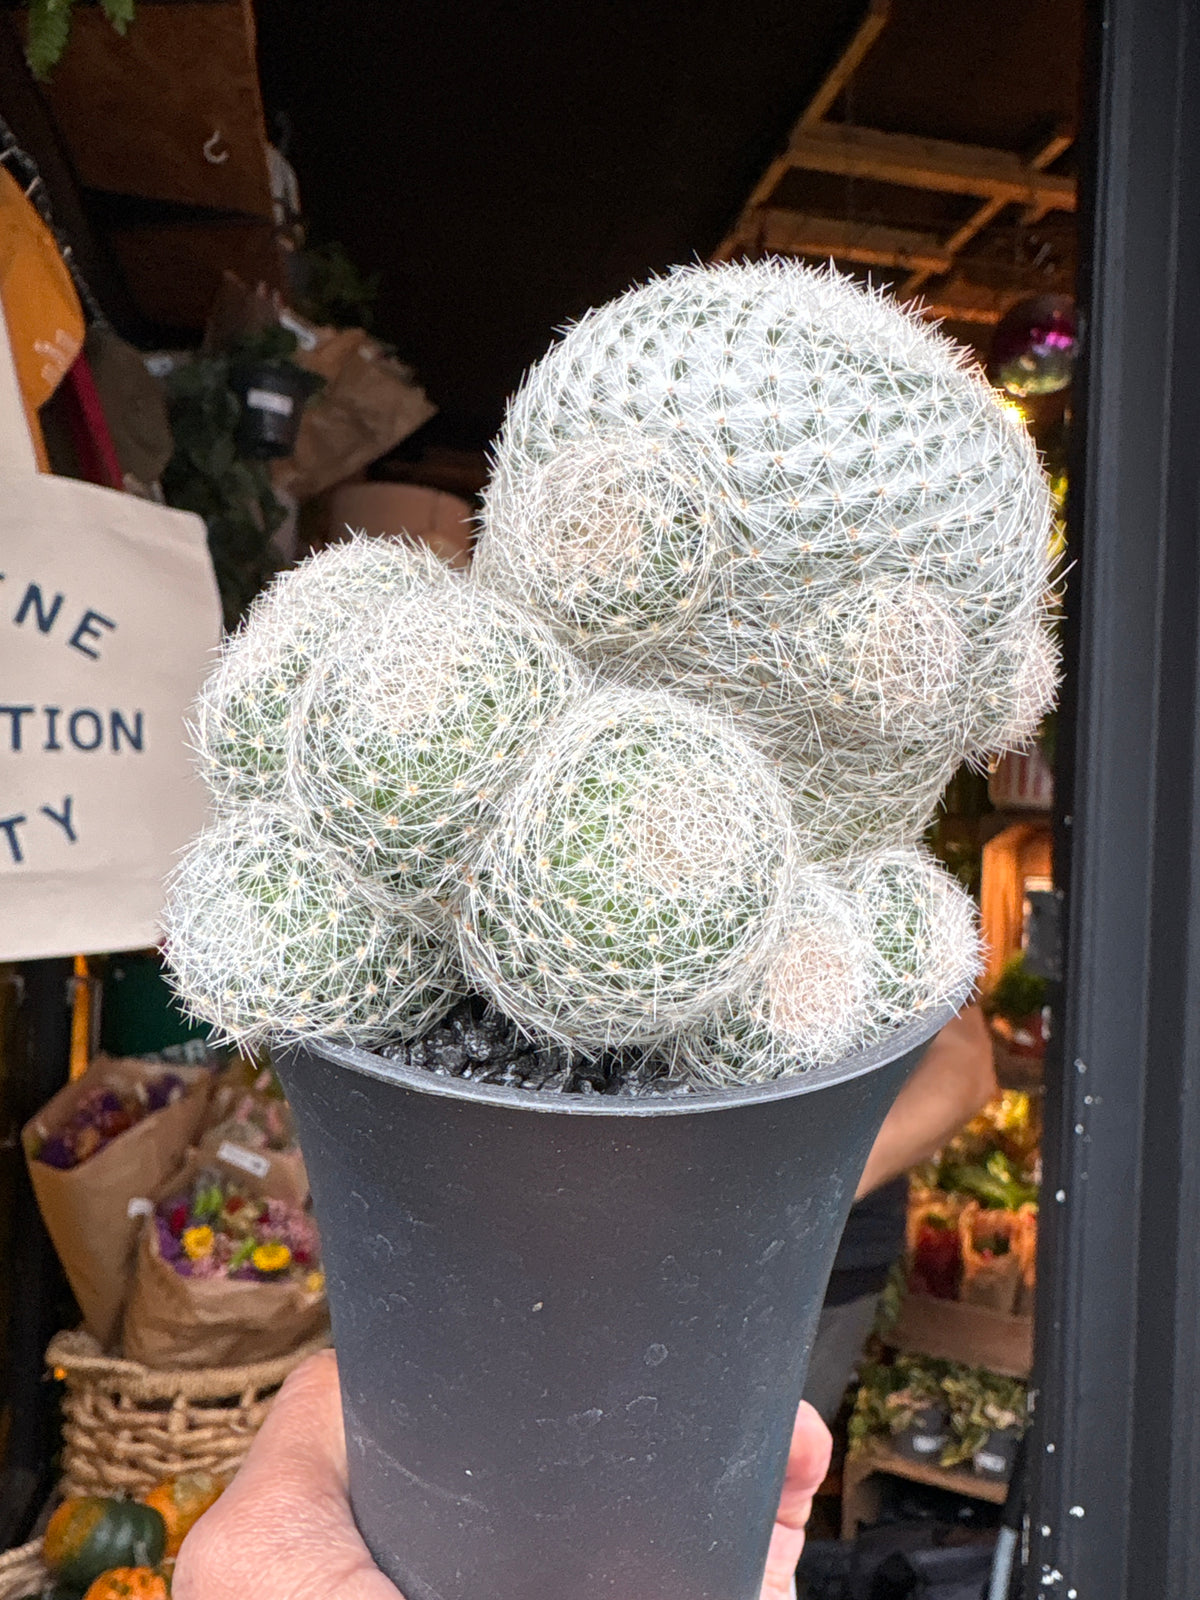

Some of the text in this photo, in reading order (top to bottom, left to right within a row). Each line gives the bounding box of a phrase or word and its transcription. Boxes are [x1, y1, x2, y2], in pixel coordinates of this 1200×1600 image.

[0, 574, 116, 660] NE
[0, 706, 144, 752] TION
[0, 798, 76, 862] TY
